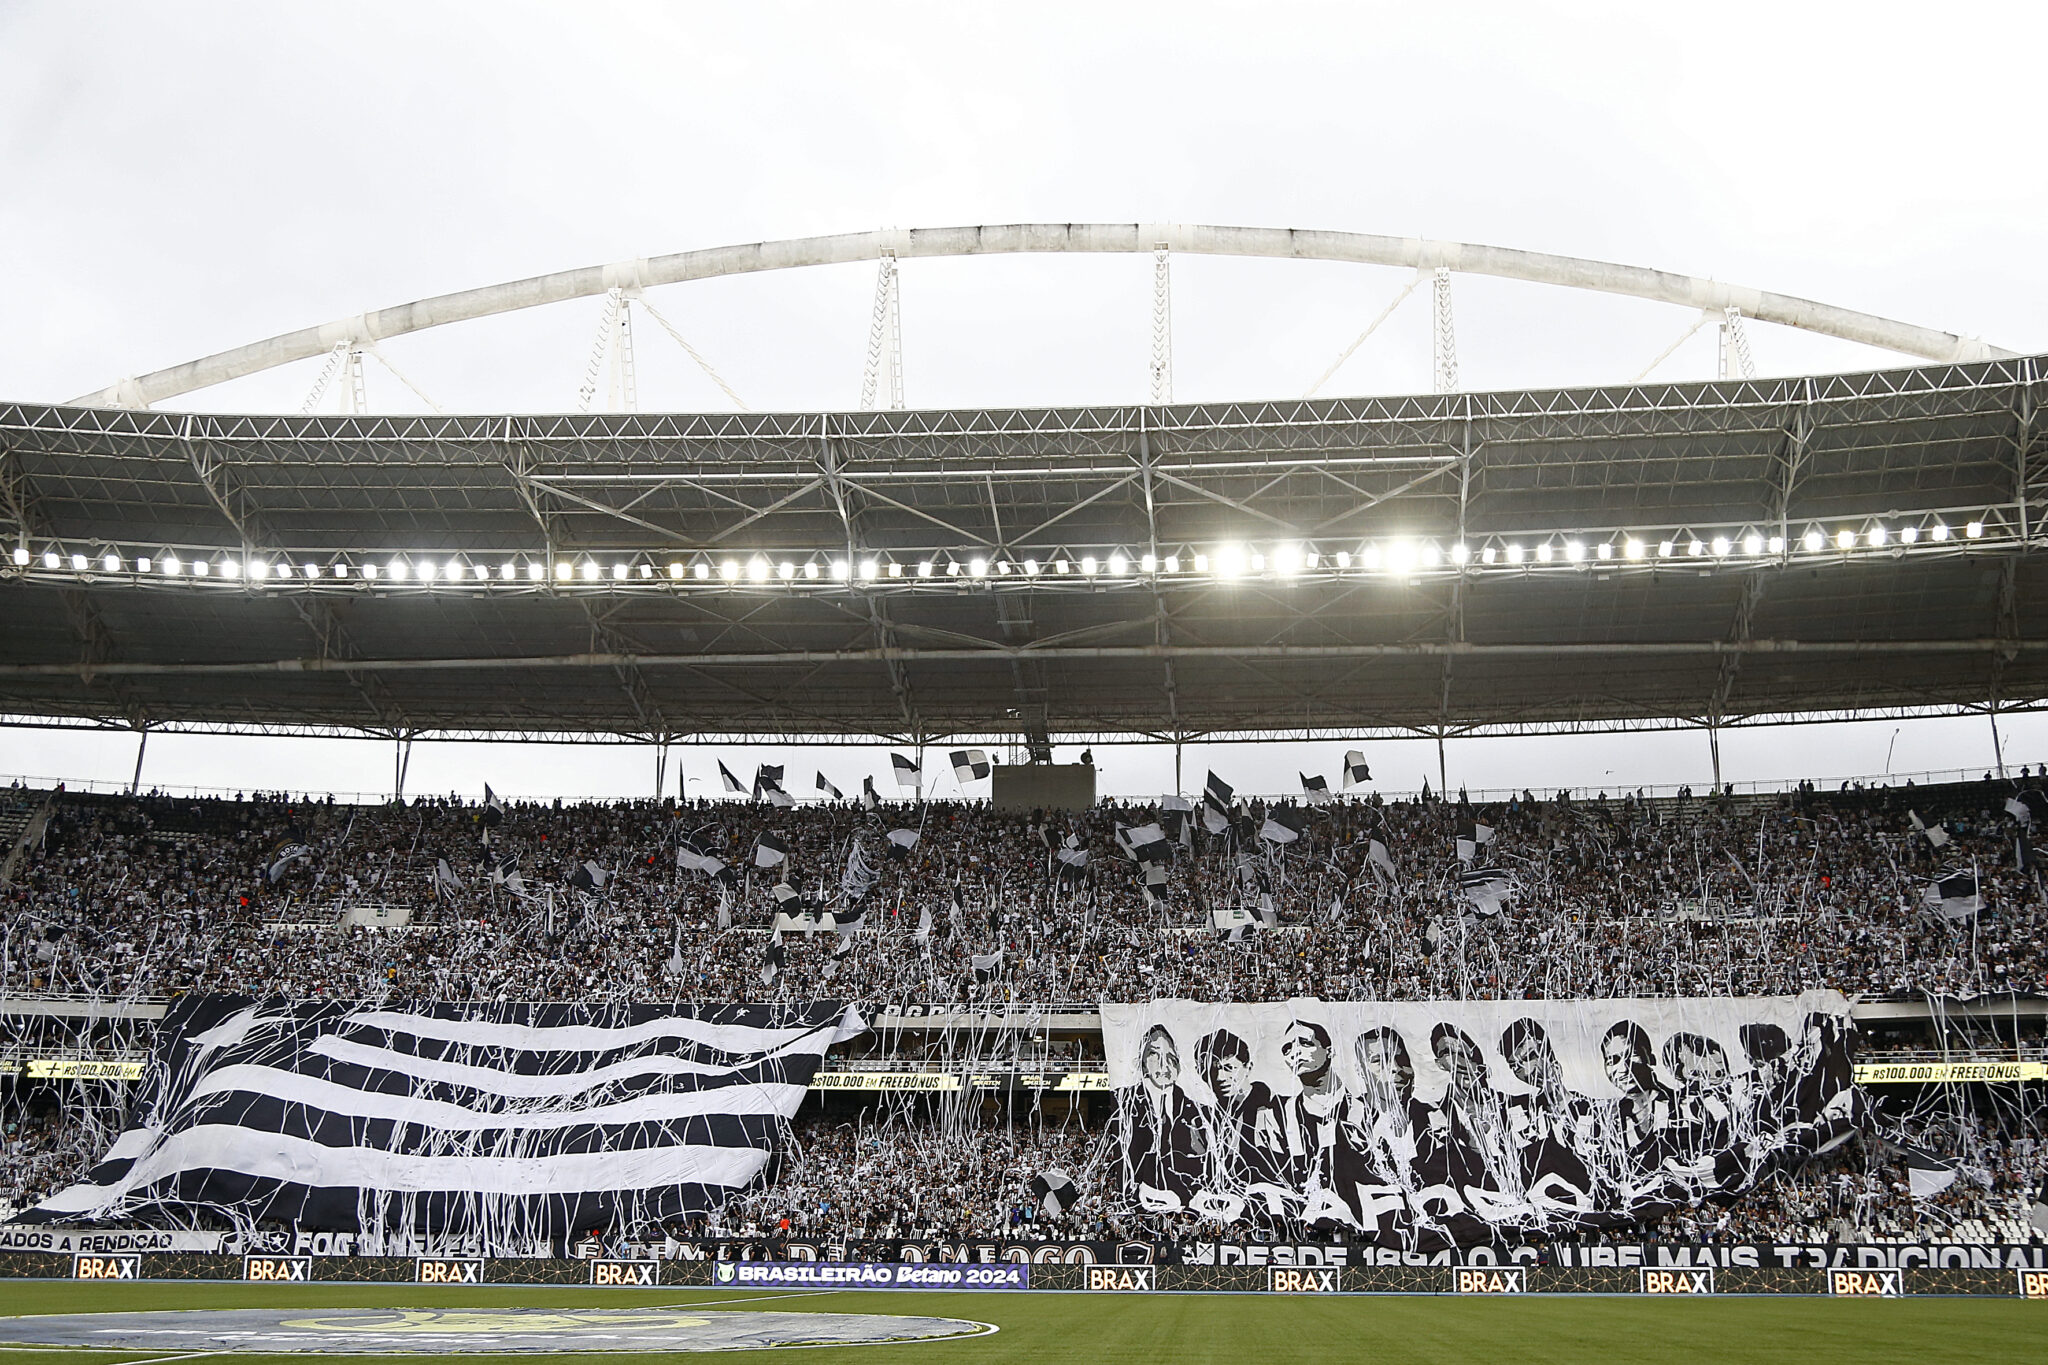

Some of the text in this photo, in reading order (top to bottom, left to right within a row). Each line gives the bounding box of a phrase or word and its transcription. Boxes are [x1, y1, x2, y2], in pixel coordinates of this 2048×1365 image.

[865, 1078, 877, 1087] EM
[0, 1231, 53, 1248] ADOS
[59, 1237, 72, 1250] A
[1220, 1245, 1348, 1266] DESDE
[1658, 1246, 1760, 1268] MAIS
[79, 1258, 134, 1279] BRAX
[250, 1260, 305, 1281] BRAX
[421, 1262, 478, 1283] BRAX
[597, 1264, 654, 1285] BRAX
[738, 1264, 1020, 1284] BRASILEIRÃO Betano 2024
[1091, 1269, 1150, 1290] BRAX
[1274, 1270, 1334, 1291] BRAX
[1459, 1271, 1521, 1293] BRAX
[1646, 1272, 1708, 1293] BRAX
[1834, 1273, 1897, 1294] BRAX
